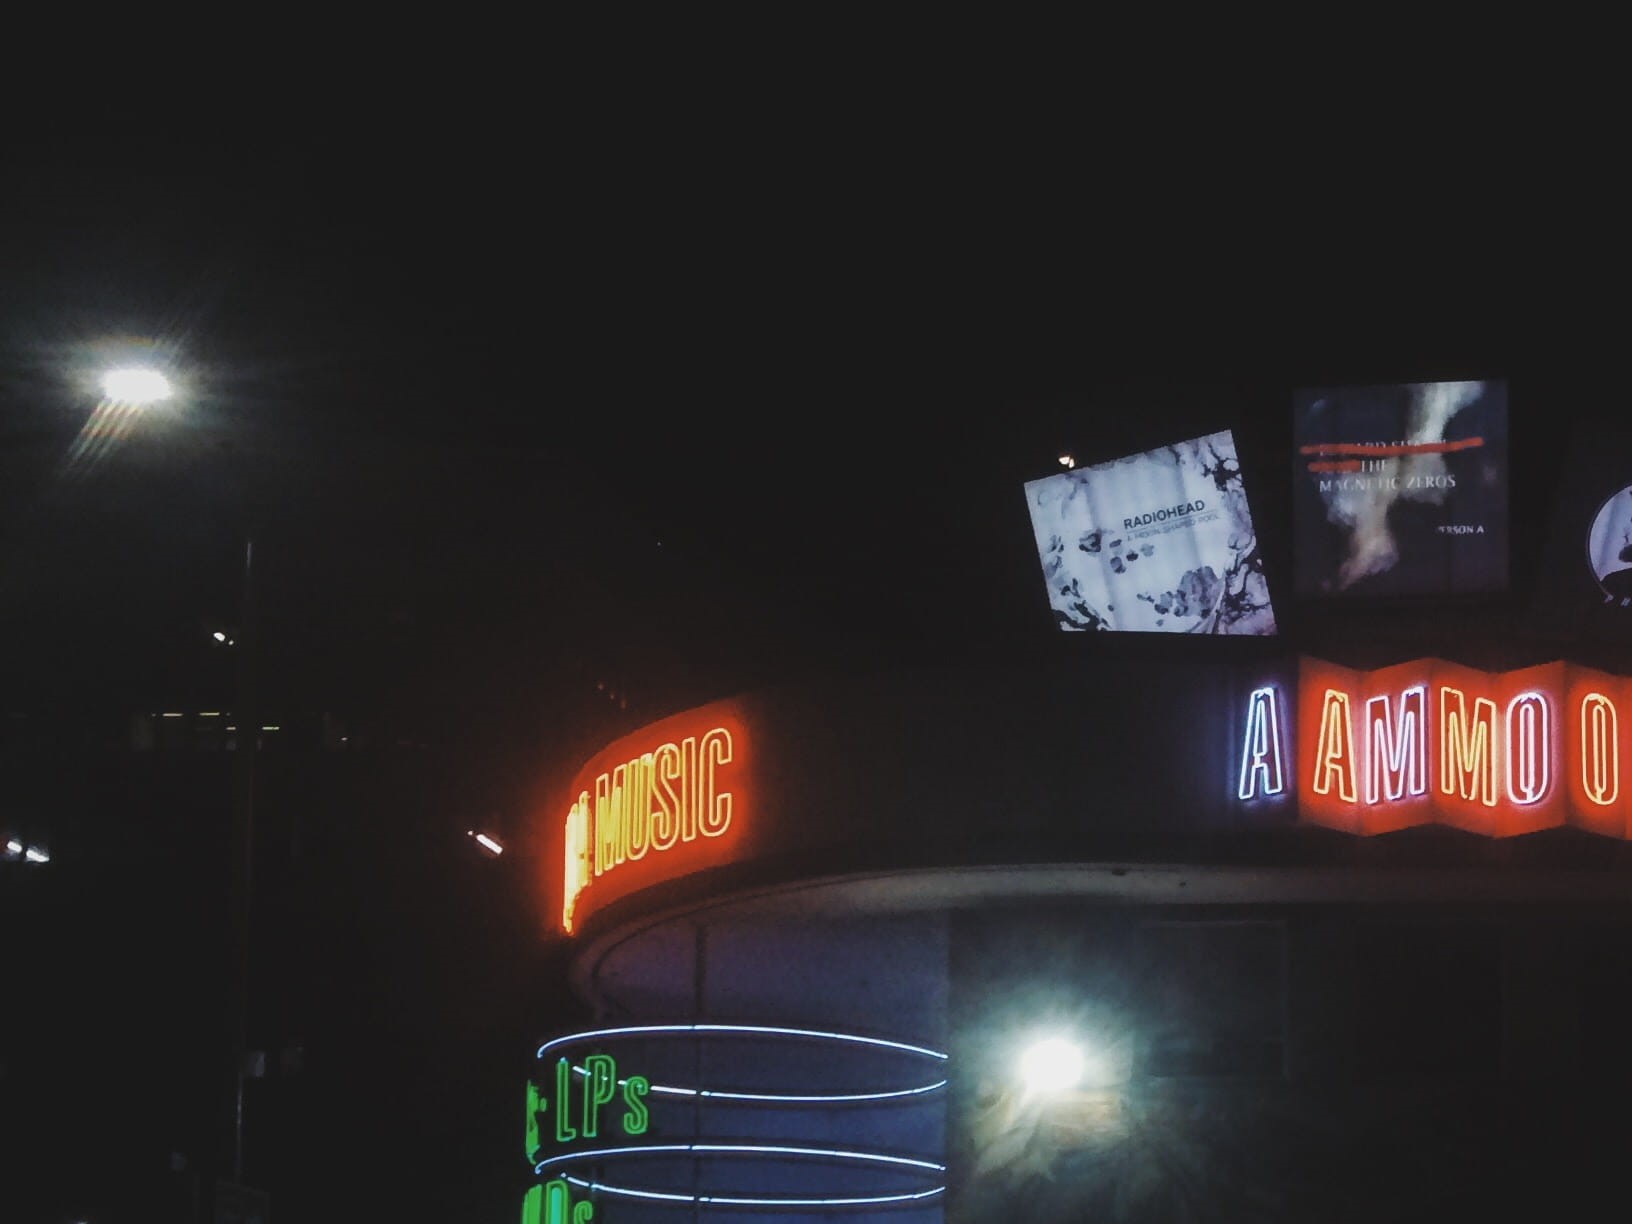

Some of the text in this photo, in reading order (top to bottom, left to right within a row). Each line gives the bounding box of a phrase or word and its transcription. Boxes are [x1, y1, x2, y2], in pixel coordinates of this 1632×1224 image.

[1406, 473, 1457, 490] ZEROS
[1123, 499, 1205, 529] RADIOHEAD
[1477, 523, 1486, 534] A
[595, 727, 733, 877] MUSIC
